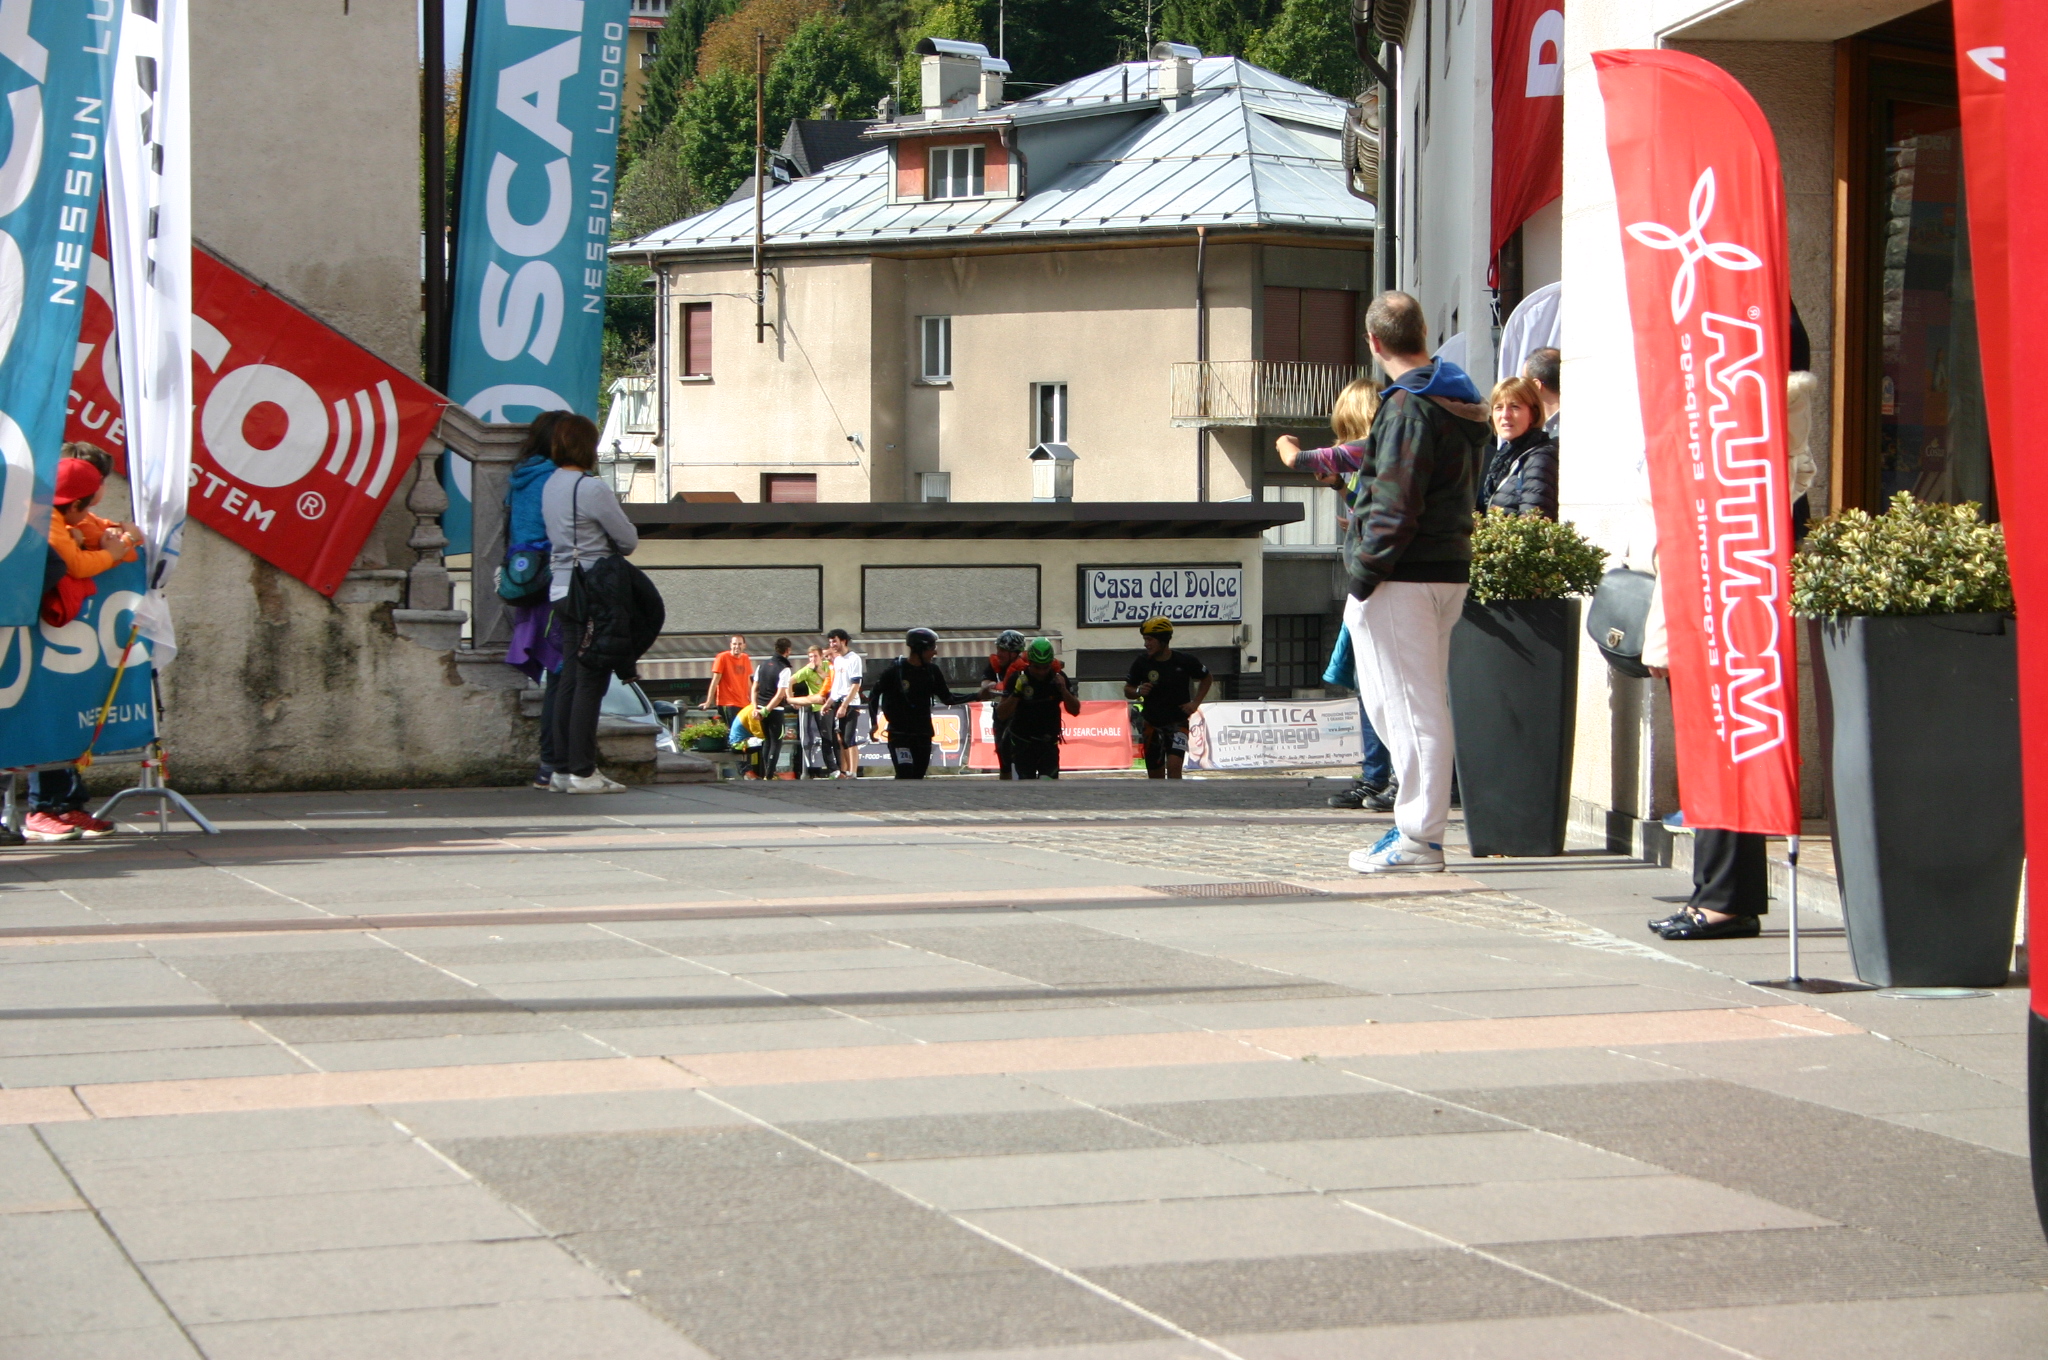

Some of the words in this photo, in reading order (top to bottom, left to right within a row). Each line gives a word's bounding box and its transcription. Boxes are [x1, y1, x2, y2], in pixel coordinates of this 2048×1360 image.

[595, 21, 622, 134] LUOGO
[50, 96, 103, 305] NESSUN
[583, 163, 611, 314] NESSUN
[1093, 571, 1144, 599] Casa
[1149, 571, 1179, 598] del
[1184, 571, 1237, 598] Dolce
[1111, 600, 1220, 621] Pasticceria
[77, 702, 148, 729] NESSUN
[1241, 708, 1318, 724] OTTICA
[1073, 727, 1121, 737] SEARCHABLE
[1217, 725, 1321, 749] demenego
